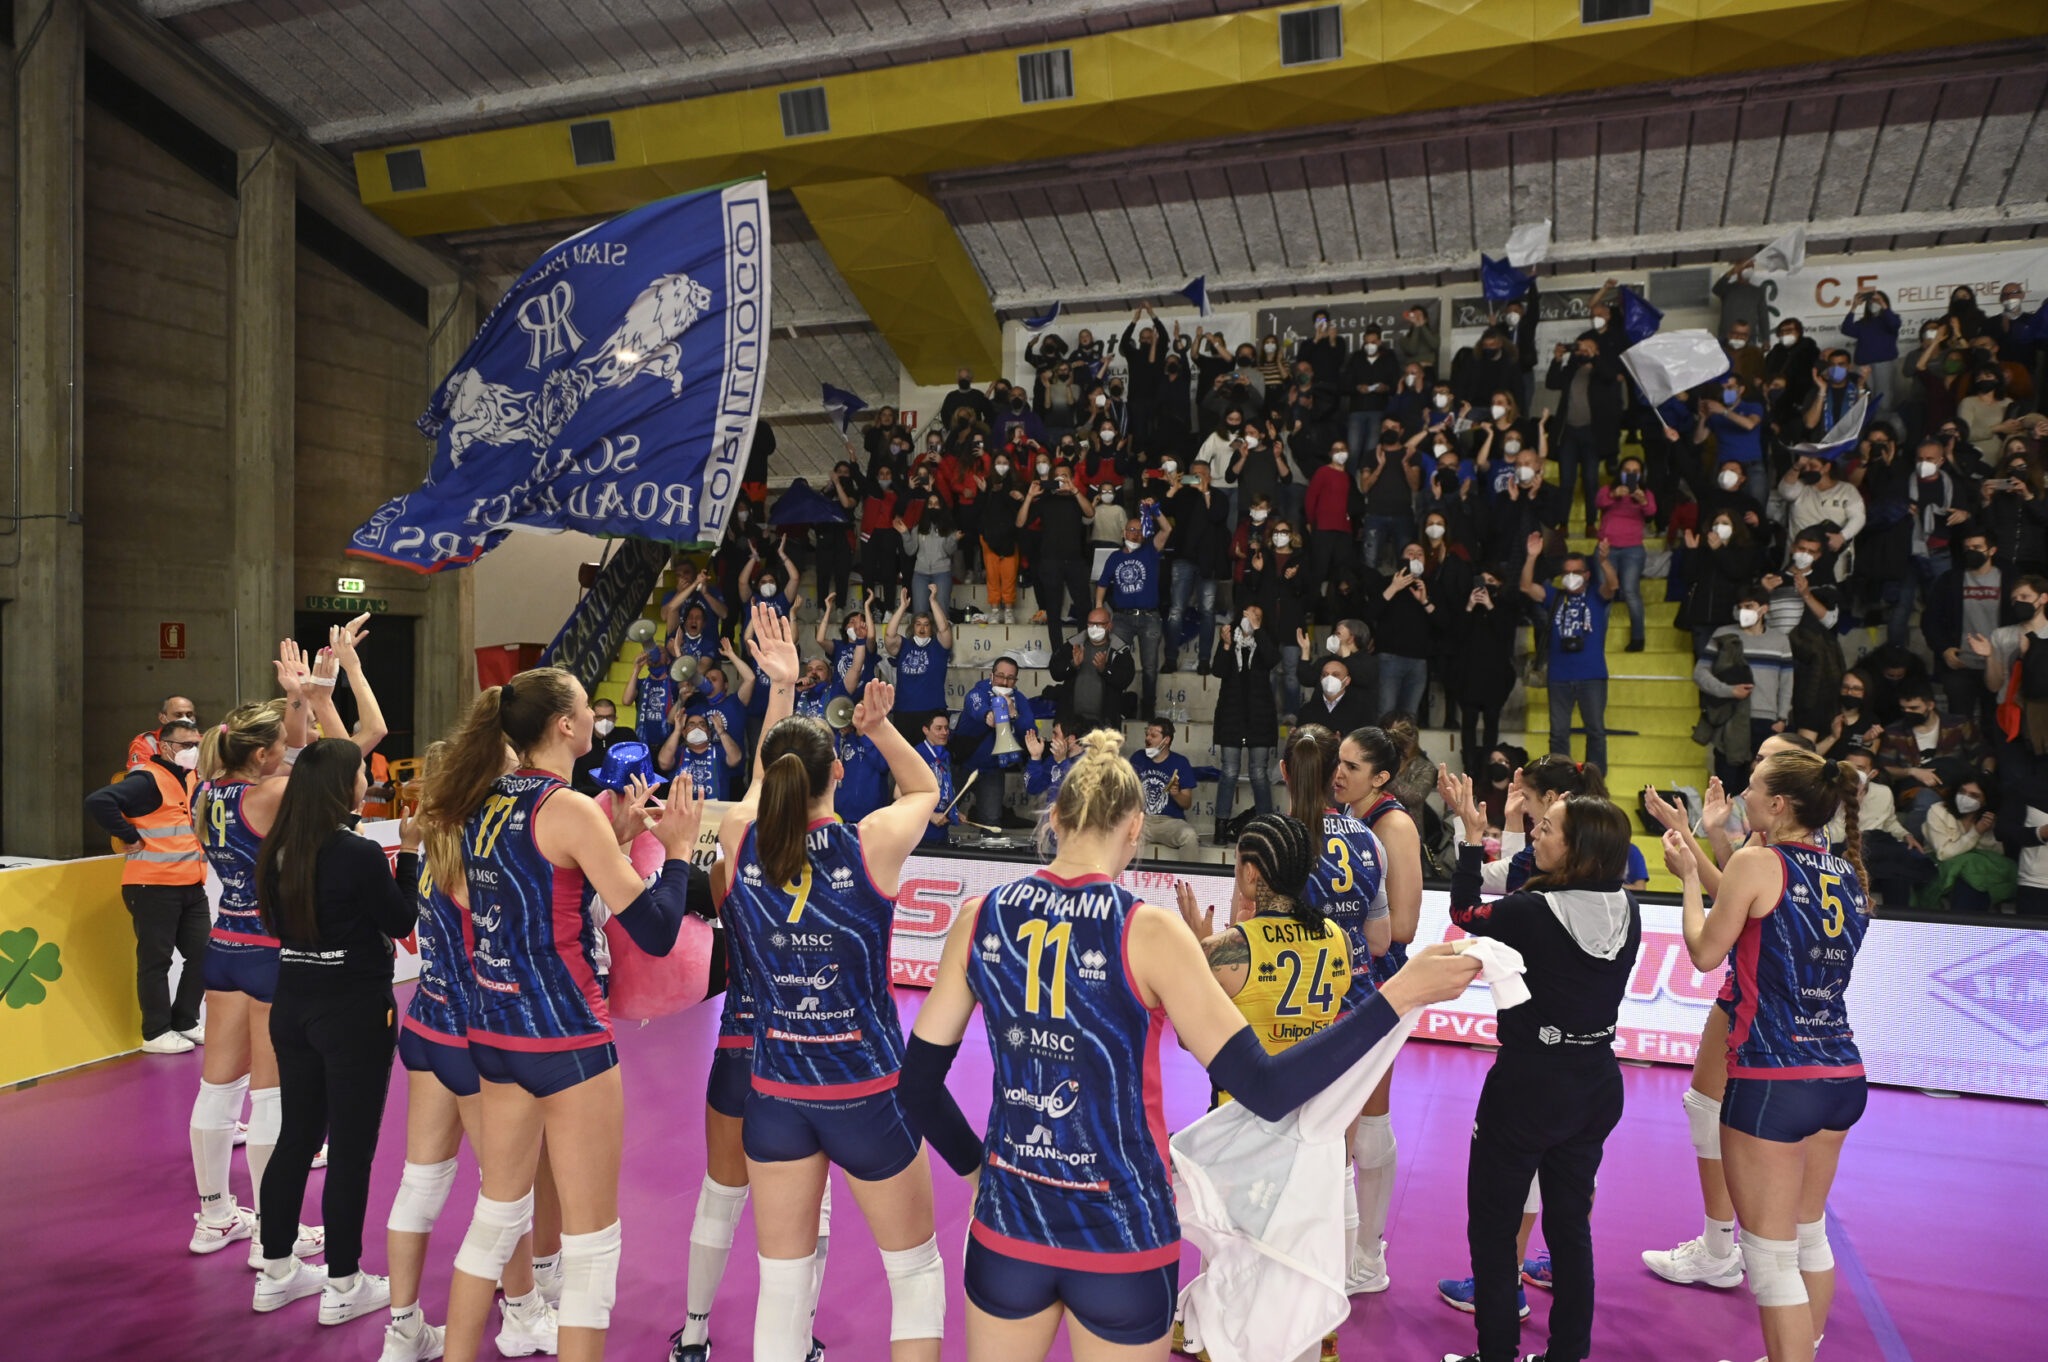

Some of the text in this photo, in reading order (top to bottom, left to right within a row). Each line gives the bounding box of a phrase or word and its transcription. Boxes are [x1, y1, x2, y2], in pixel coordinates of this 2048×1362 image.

[1330, 314, 1396, 329] stetica
[309, 597, 373, 612] USCITA
[974, 640, 991, 651] 50
[1024, 639, 1042, 651] 49
[949, 684, 965, 696] 50
[1165, 689, 1186, 702] 46
[1192, 801, 1215, 816] 45
[474, 794, 519, 859] 17
[1327, 837, 1354, 893] 3
[476, 868, 499, 884] MSC
[997, 884, 1114, 921] LIPPMANN
[1335, 900, 1360, 912] MSC
[1819, 873, 1845, 938] 5
[790, 933, 832, 946] MSC
[1824, 948, 1847, 961] MSC
[1016, 918, 1073, 1021] 11
[1275, 948, 1334, 1017] 24
[1030, 1028, 1076, 1052] MSC
